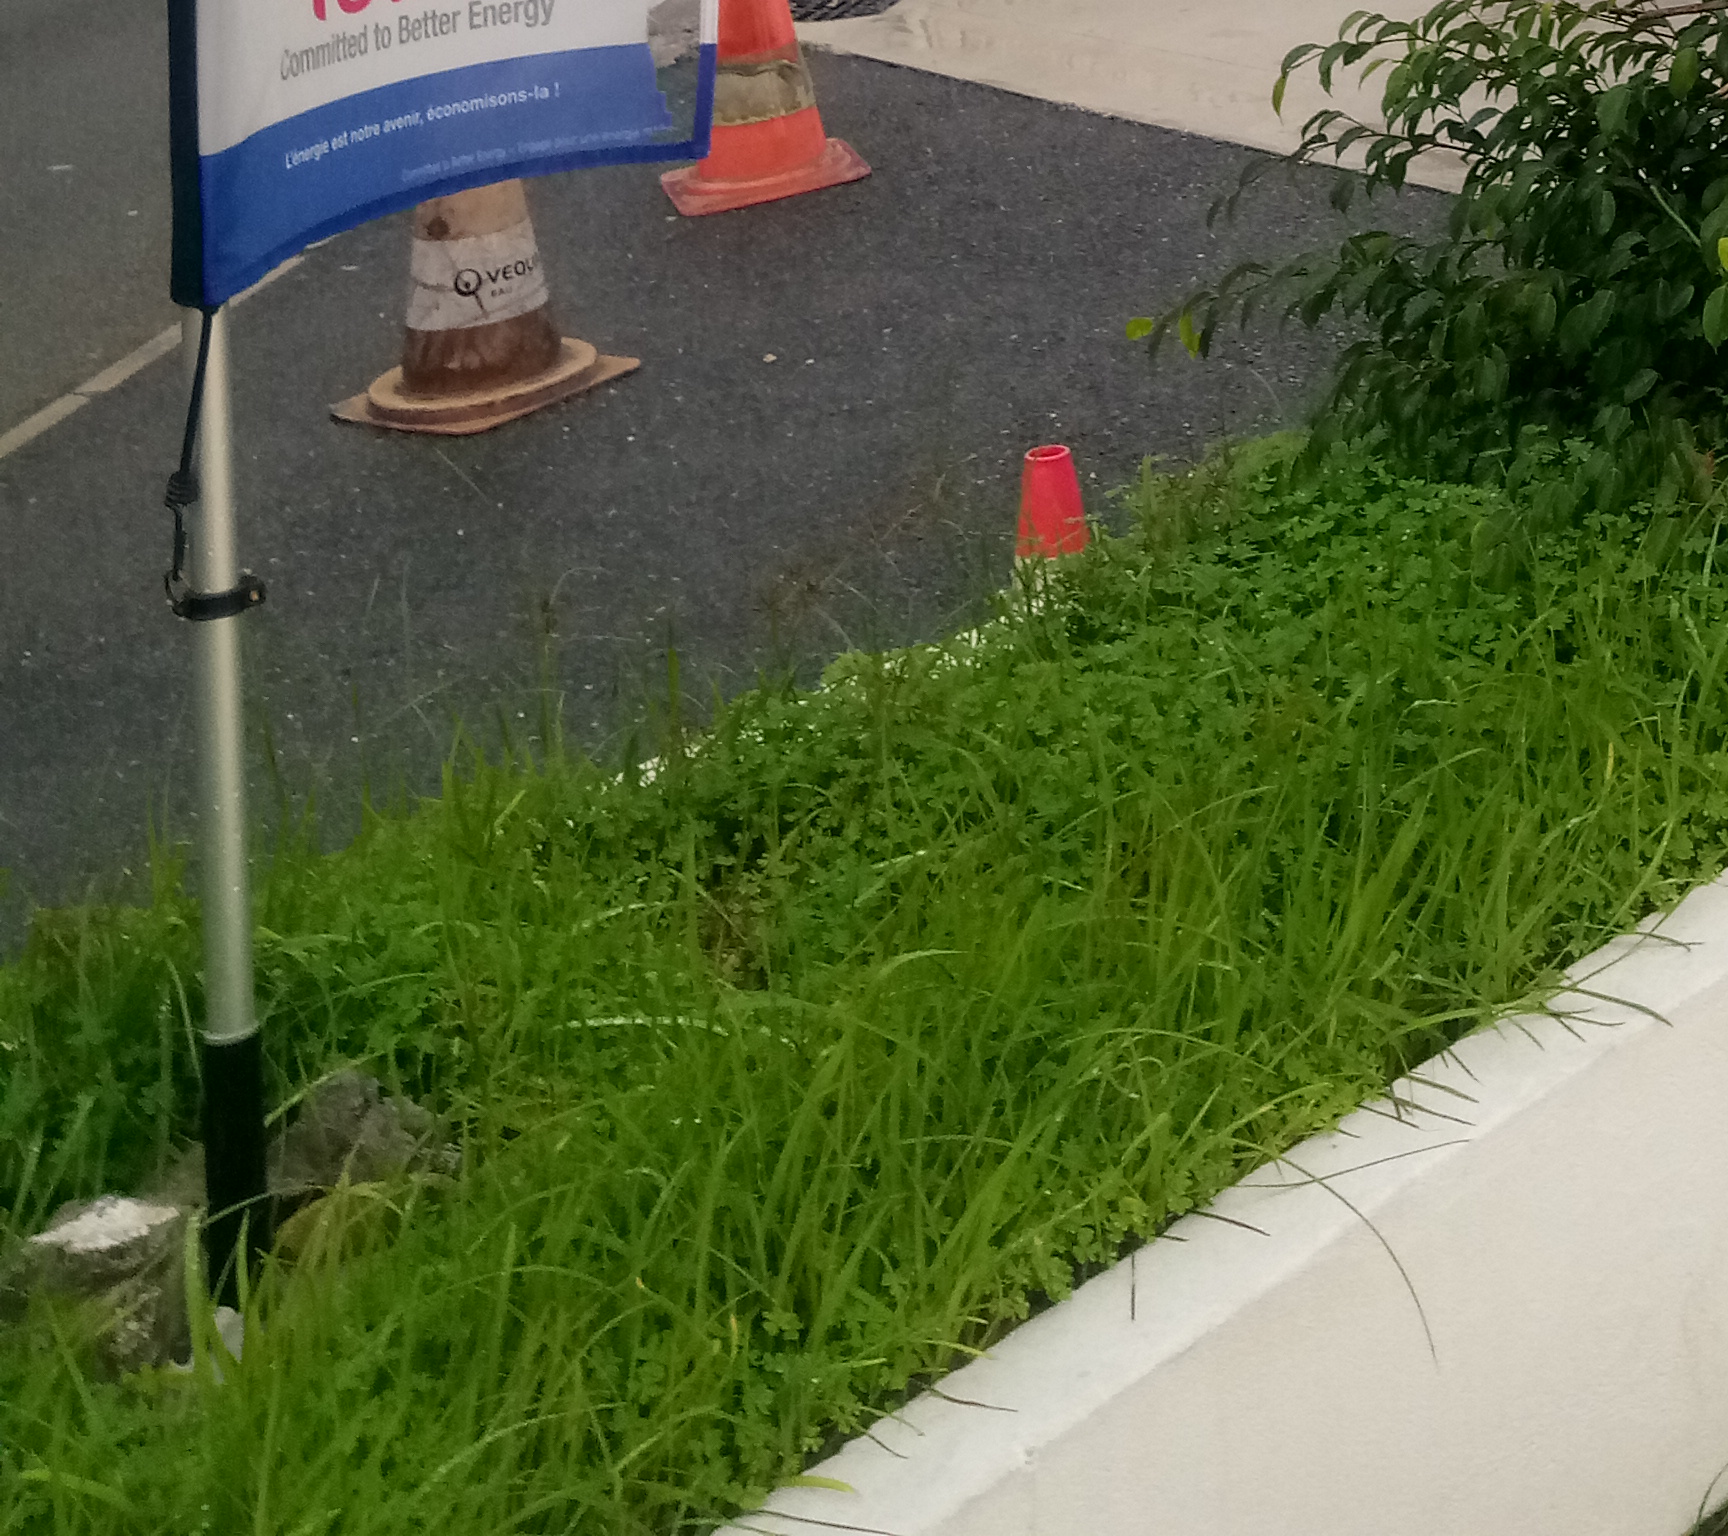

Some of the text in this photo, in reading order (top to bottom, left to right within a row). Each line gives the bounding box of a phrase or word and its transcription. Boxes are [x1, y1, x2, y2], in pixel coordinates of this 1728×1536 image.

[280, 24, 369, 81] Committed
[373, 22, 393, 52] to
[398, 9, 462, 44] Better
[331, 131, 349, 151] est
[349, 121, 381, 144] notre
